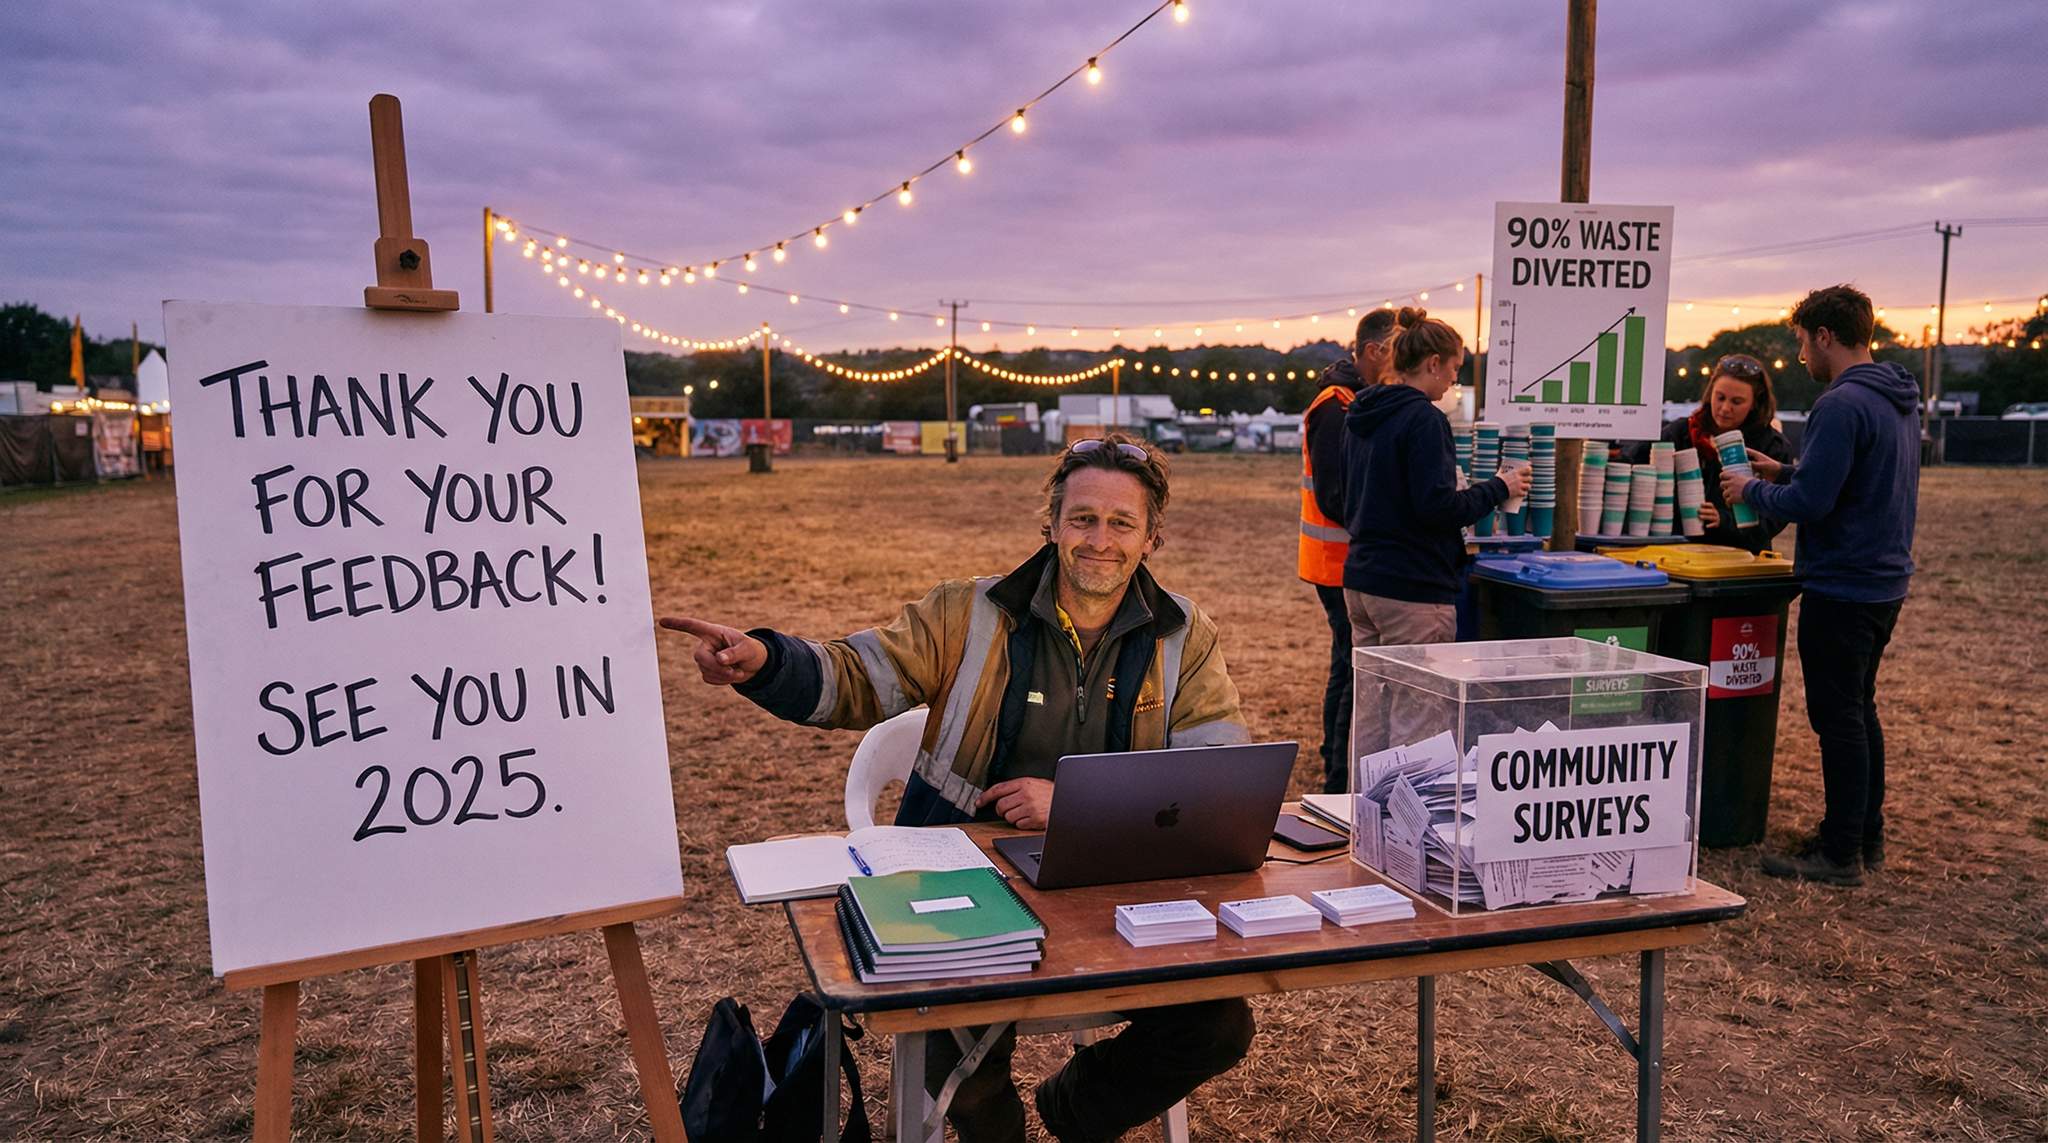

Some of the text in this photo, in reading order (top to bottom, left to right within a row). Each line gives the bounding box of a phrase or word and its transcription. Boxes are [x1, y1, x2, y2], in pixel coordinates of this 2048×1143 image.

[1507, 216, 1661, 252] 90% WASTE
[1511, 257, 1652, 289] DIVERTED
[199, 360, 583, 444] THANK YOU
[251, 464, 567, 535] FOR YOUR
[254, 533, 607, 629] FEEDBACK!
[1732, 642, 1760, 660] 90%
[1732, 661, 1758, 673] WASTE
[1585, 677, 1629, 693] SURVEYS
[1726, 672, 1762, 686] DIVERTED
[257, 656, 615, 755] SEE YOU IN
[1490, 739, 1678, 792] COMMUNITY
[352, 748, 563, 842] 2025.
[1513, 793, 1651, 844] SURVEYS
